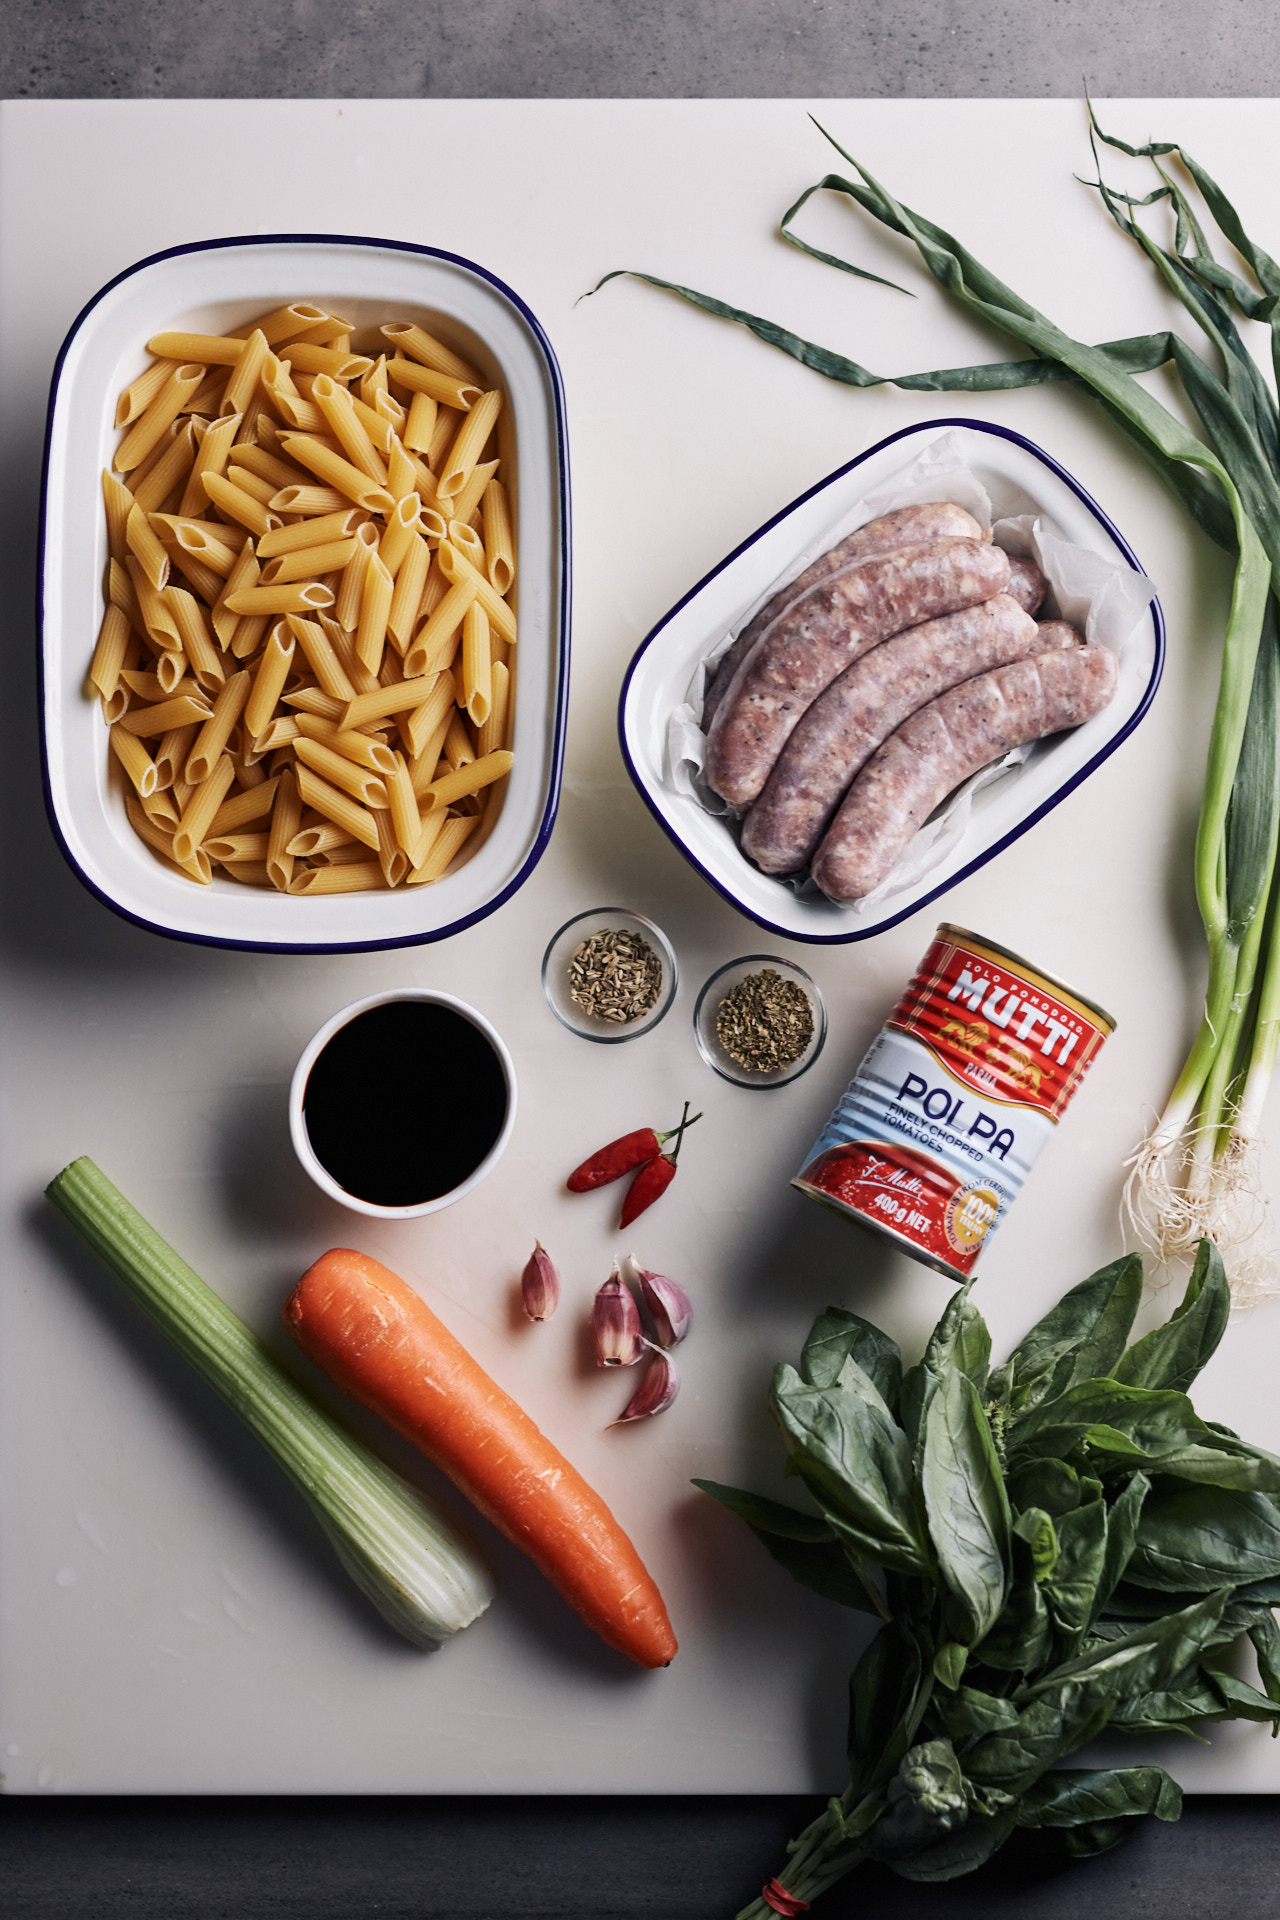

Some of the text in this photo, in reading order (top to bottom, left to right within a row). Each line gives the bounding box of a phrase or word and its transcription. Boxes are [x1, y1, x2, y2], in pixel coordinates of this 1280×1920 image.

[965, 961, 1001, 982] SOLO
[947, 969, 1079, 1066] MUTTI
[963, 1062, 998, 1089] PARMA
[882, 1112, 943, 1153] TOMATOES
[889, 1103, 984, 1162] FINELY CHOPPED
[895, 1071, 1015, 1161] POLPA
[874, 1193, 932, 1233] 400 g NET
[959, 1215, 984, 1235] ITALIAN
[961, 1195, 996, 1225] 100%
